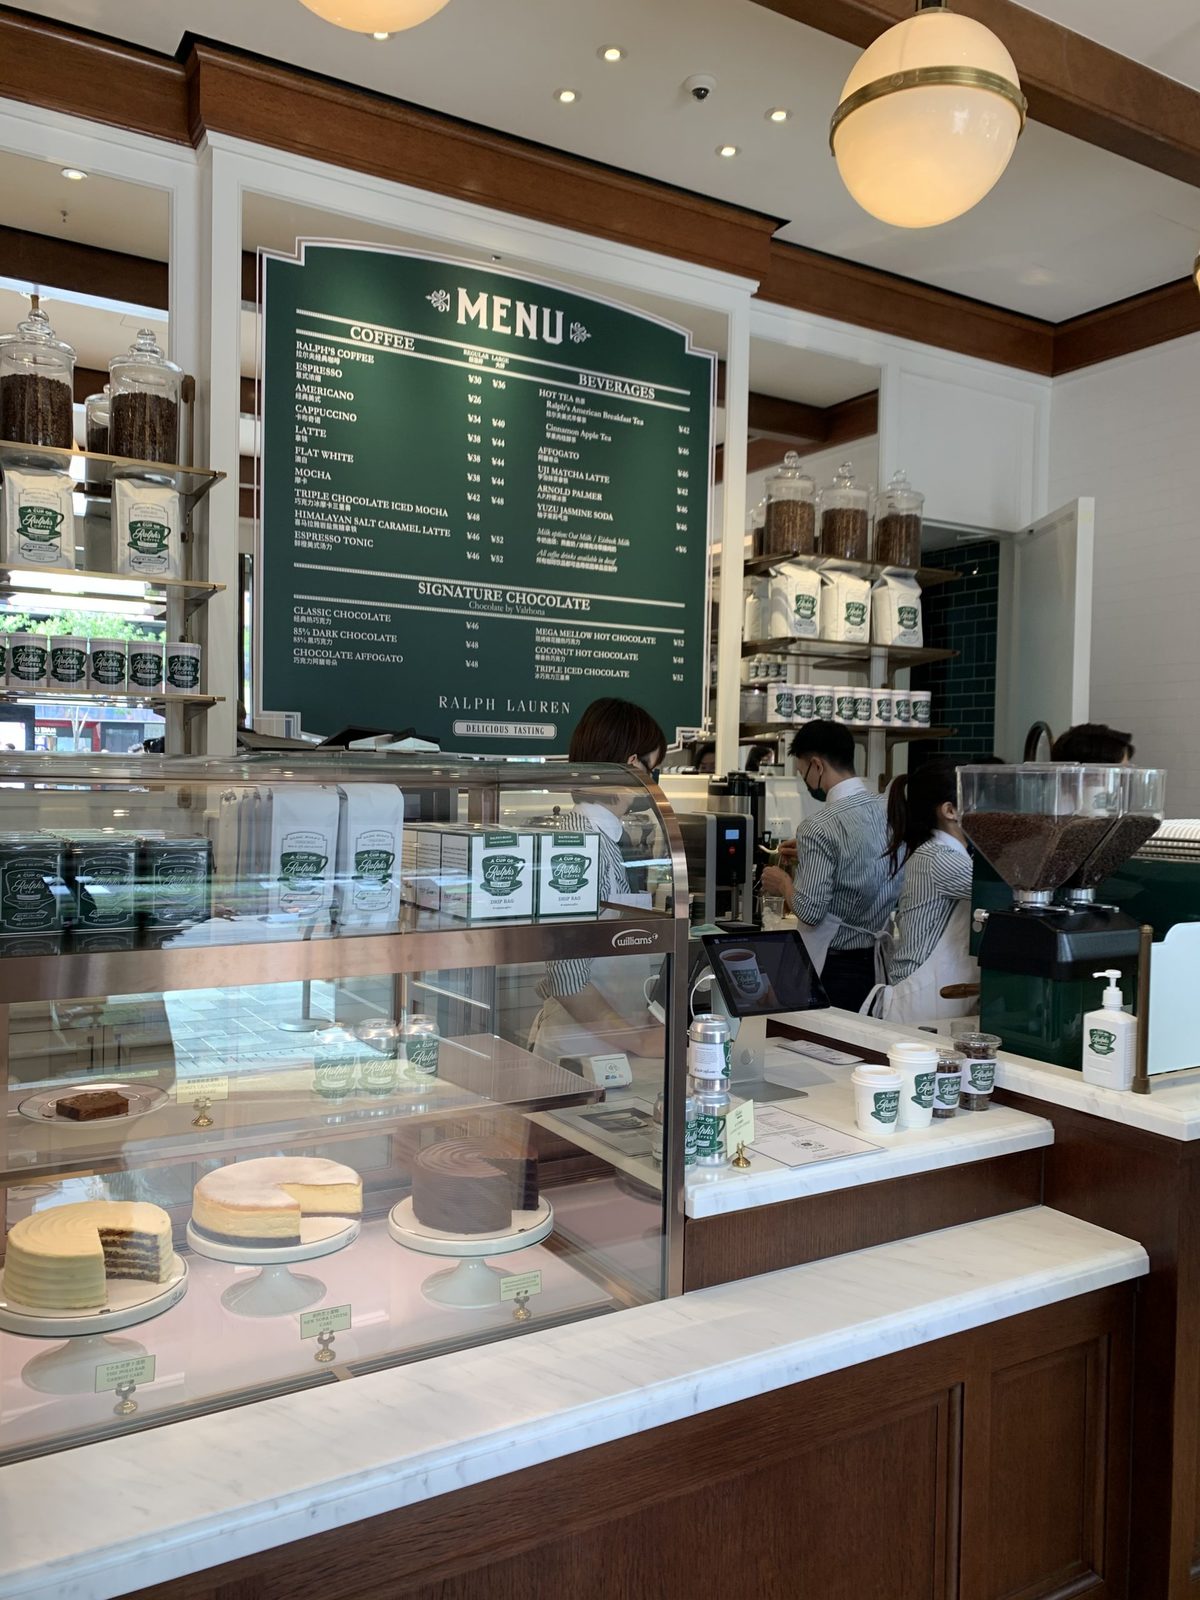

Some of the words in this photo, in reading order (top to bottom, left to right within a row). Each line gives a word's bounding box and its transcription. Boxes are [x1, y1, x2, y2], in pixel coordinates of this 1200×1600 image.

[456, 287, 564, 345] MENU
[350, 326, 416, 351] COFFEE
[296, 340, 336, 356] RALPH'S
[337, 348, 375, 364] COFFEE
[295, 362, 343, 378] ESPRESSO
[295, 383, 354, 401] AMERICANO
[539, 388, 557, 399] HOT
[558, 392, 574, 402] TEA
[579, 373, 656, 400] BEVERAGES
[295, 404, 357, 422] CAPPUCCINO
[546, 400, 570, 412] Ralph's
[572, 406, 601, 418] American
[603, 411, 632, 423] Breakfast
[633, 416, 644, 426] Tea
[295, 425, 327, 438] LATTE
[546, 423, 580, 436] Cinnamon
[580, 430, 599, 441] Apple
[600, 433, 612, 442] Tea
[295, 446, 319, 457] FLAT
[321, 450, 354, 463] WHITE
[538, 446, 580, 460] AFFOGATO
[294, 467, 332, 480] MOCHA
[538, 465, 549, 476] UJI
[551, 467, 585, 480] MATCHA
[586, 473, 610, 484] LATTE
[537, 484, 571, 496] ARNOLD
[571, 489, 603, 501] PALMER
[294, 488, 330, 501] TRIPLE
[331, 493, 390, 509] CHOCOLATE
[391, 501, 414, 512] ICED
[415, 505, 449, 518] MOCHA
[537, 503, 559, 513] YUZU
[560, 506, 593, 518] JASMINE
[593, 511, 614, 521] SODA
[294, 509, 352, 524] HIMALAYAN
[354, 516, 377, 528] SALT
[378, 520, 421, 533] CARAMEL
[422, 525, 451, 538] LATTE
[294, 530, 341, 544] ESPRESSO
[343, 535, 374, 548] TONIC
[418, 581, 502, 601] SIGNATURE
[506, 591, 591, 611] CHOCOLATE
[293, 606, 332, 617] CLASSIC
[333, 609, 392, 623] CHOCOLATE
[468, 600, 503, 612] Chocolate
[505, 605, 514, 615] by
[516, 606, 546, 616] Valrhona
[465, 621, 480, 630] ¥46
[293, 627, 311, 636] 85%
[312, 628, 338, 639] DARK
[340, 630, 398, 643] CHOCOLATE
[535, 627, 559, 637] MEGA
[559, 629, 592, 640] MELLOW
[593, 632, 611, 641] HOT
[611, 633, 657, 645] CHOCOLATE
[293, 648, 353, 660] CHOCOLATE
[355, 652, 404, 663] AFFOGATO
[535, 646, 575, 656] COCONUT
[575, 649, 593, 657] HOT
[593, 650, 639, 661] CHOCOLATE
[535, 664, 564, 674] TRIPLE
[564, 666, 583, 675] ICED
[584, 668, 630, 678] CHOCOLATE
[439, 695, 495, 711] RALPH
[507, 699, 571, 714] LAUREN
[466, 724, 509, 735] DELICIOUS
[513, 726, 545, 735] TASTING
[283, 861, 318, 876] Ralph's
[358, 858, 387, 872] Ralph's
[485, 865, 515, 881] Ralph's
[554, 863, 581, 879] Ralph's
[11, 879, 45, 894] Ralph's
[617, 936, 653, 946] williams
